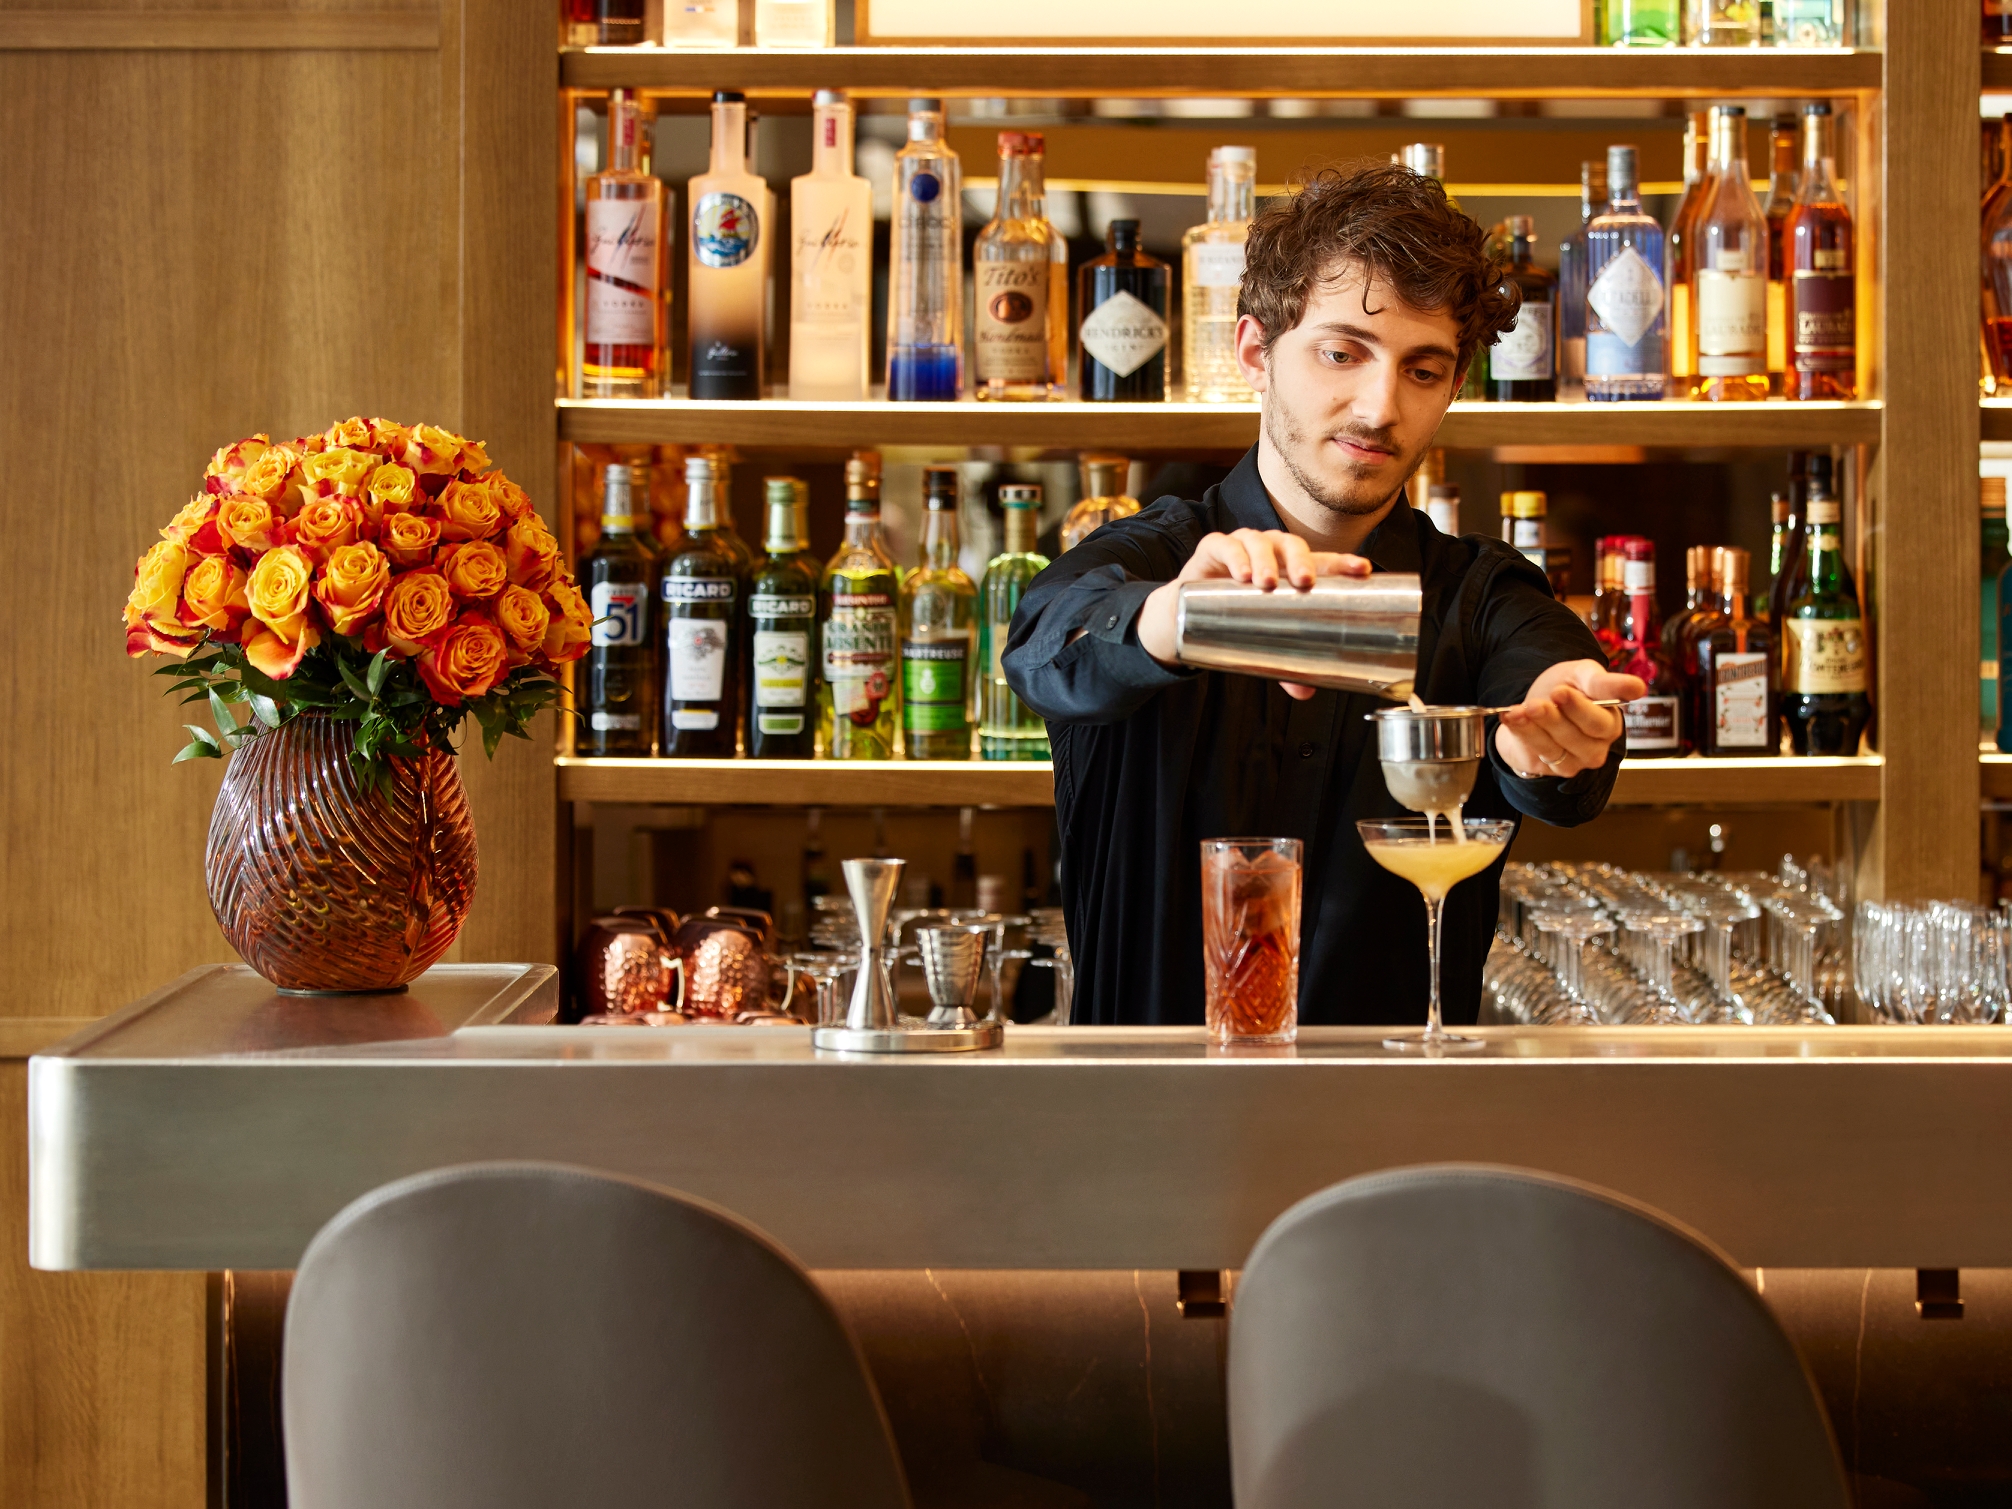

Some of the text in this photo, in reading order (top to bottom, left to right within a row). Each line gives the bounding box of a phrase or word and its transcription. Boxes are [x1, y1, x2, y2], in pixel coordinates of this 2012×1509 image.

[984, 266, 1040, 287] Tito's
[666, 583, 731, 598] RICARD
[752, 600, 811, 614] RICARD
[604, 604, 638, 640] 51
